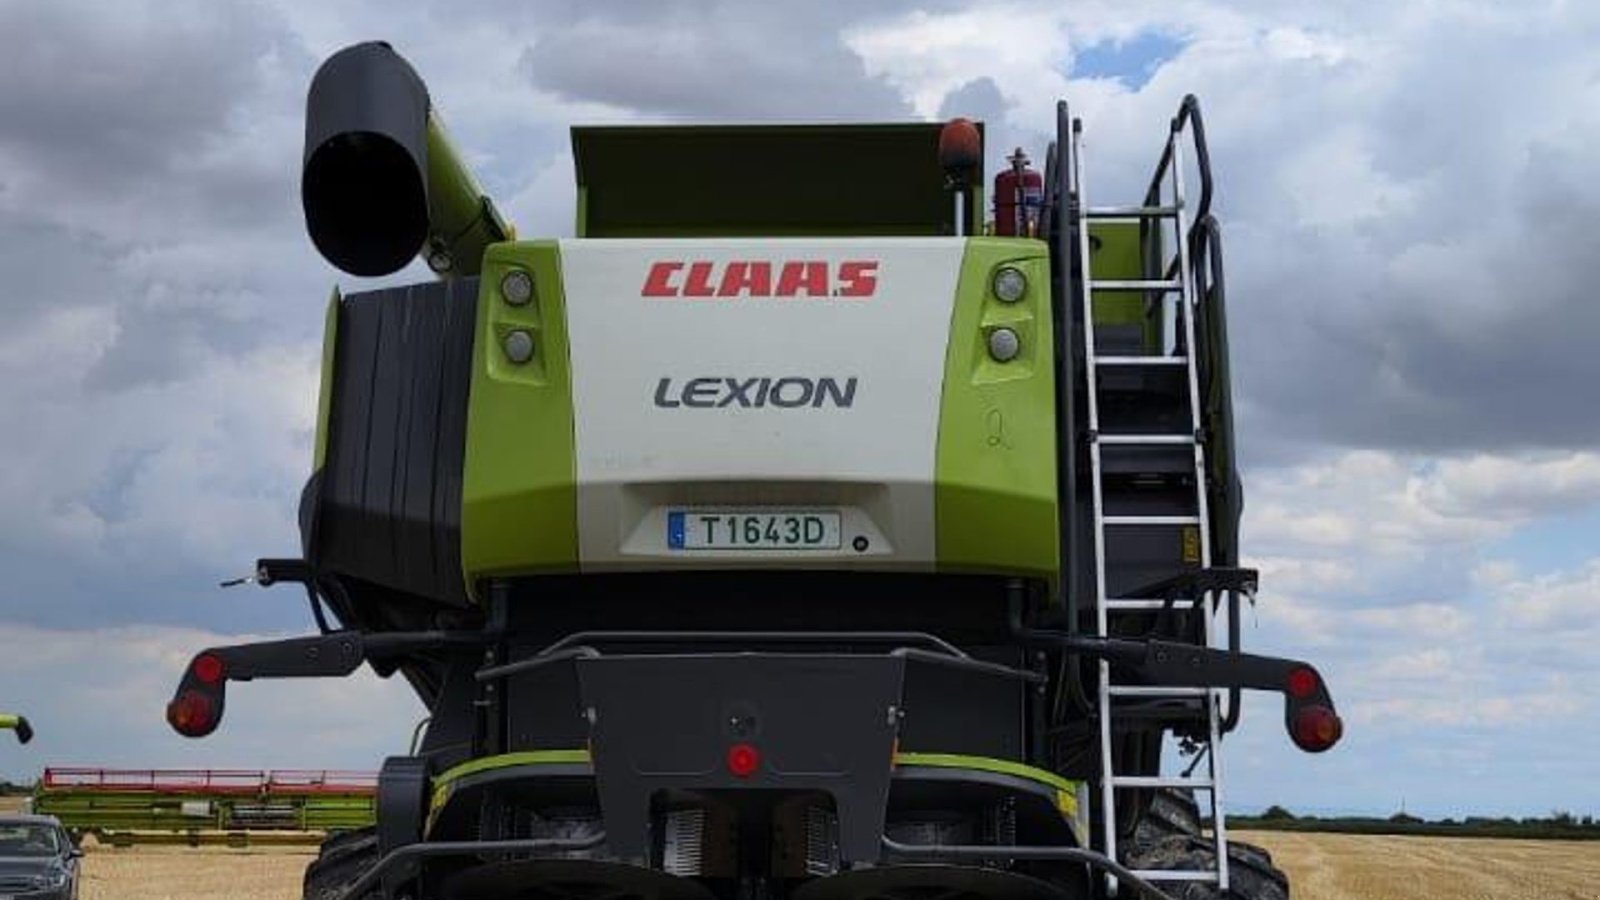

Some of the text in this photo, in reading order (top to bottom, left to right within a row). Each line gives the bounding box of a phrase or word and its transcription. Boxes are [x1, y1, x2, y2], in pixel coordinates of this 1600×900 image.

[641, 261, 878, 297] CLAAS
[653, 377, 858, 409] LEXION
[701, 515, 825, 545] T1643D
